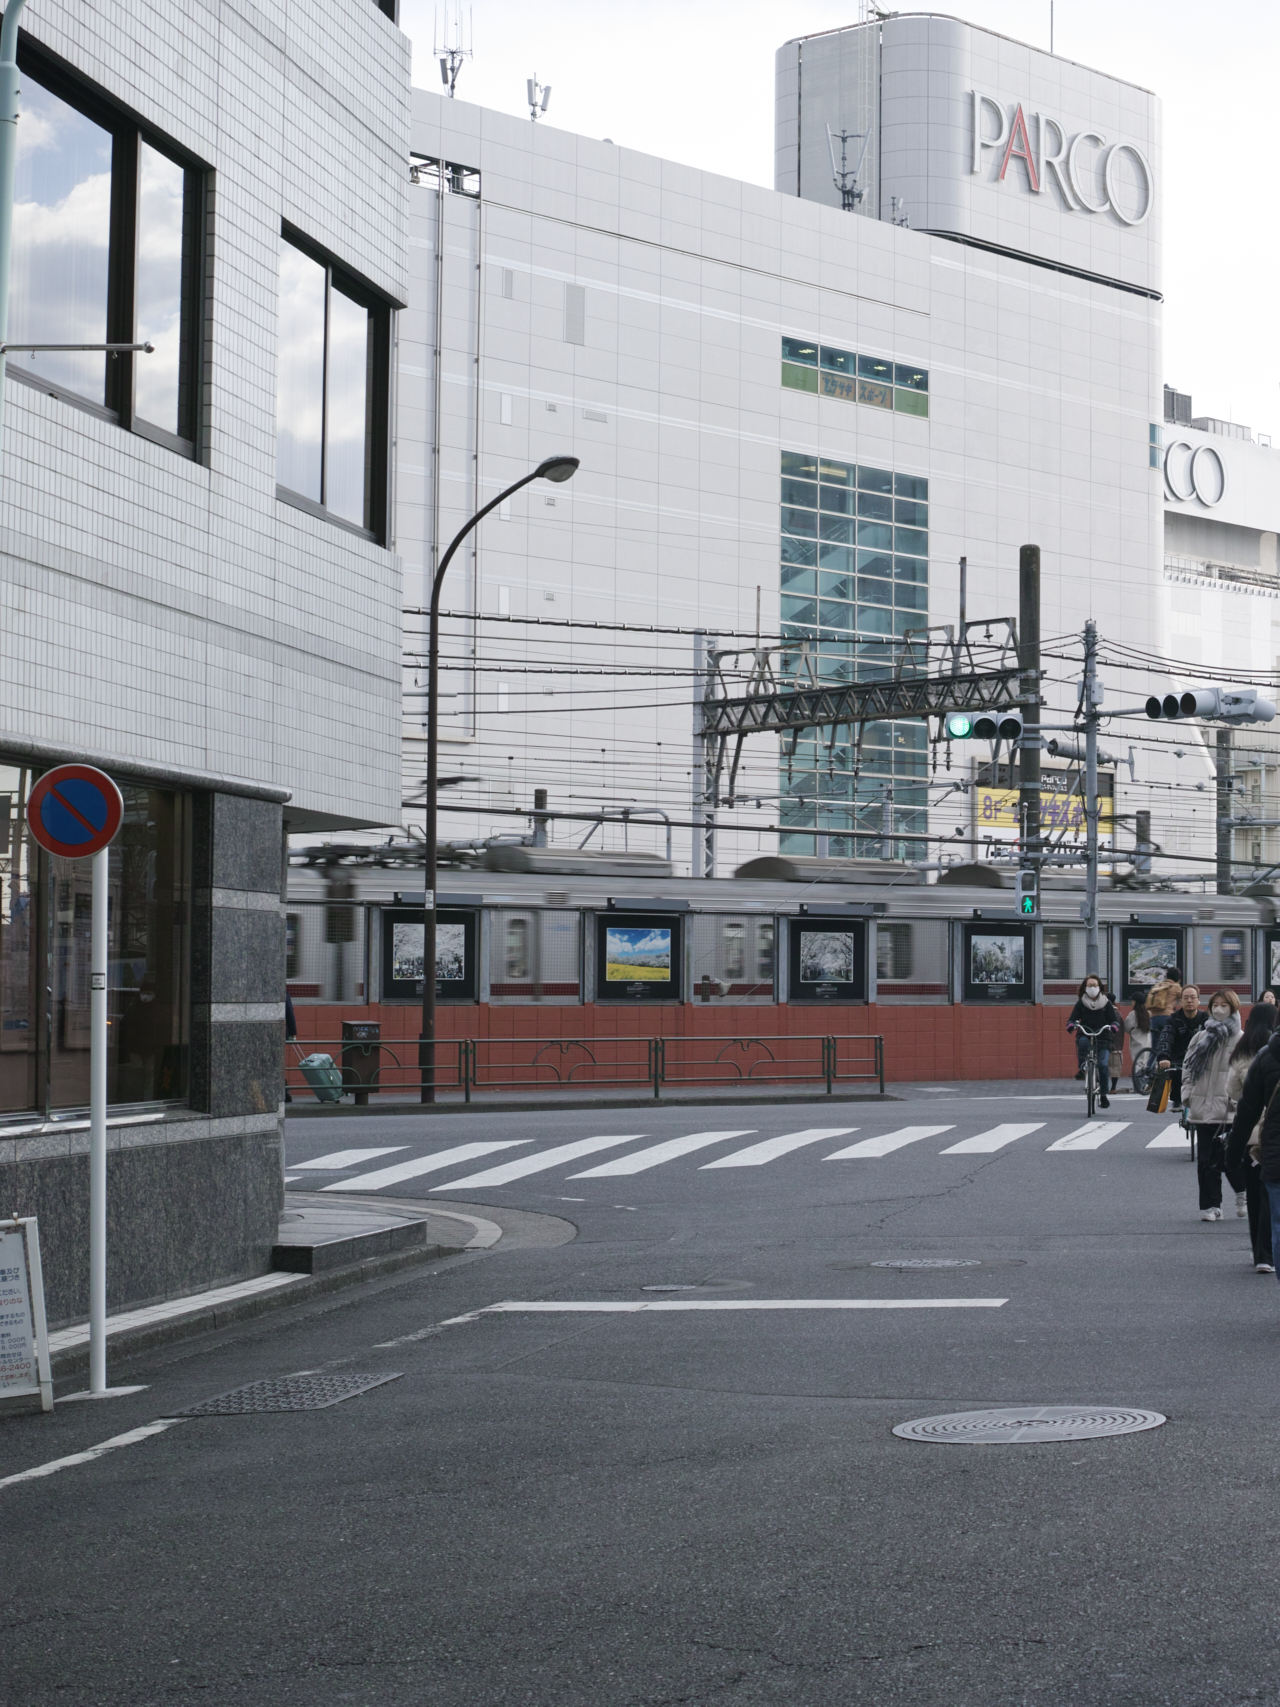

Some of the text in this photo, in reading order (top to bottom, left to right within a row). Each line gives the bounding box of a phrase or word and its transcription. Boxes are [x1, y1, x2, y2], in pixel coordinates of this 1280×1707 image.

[969, 90, 1154, 226] PARCO
[1164, 440, 1226, 508] CO
[0, 1362, 31, 1372] 6-2400
